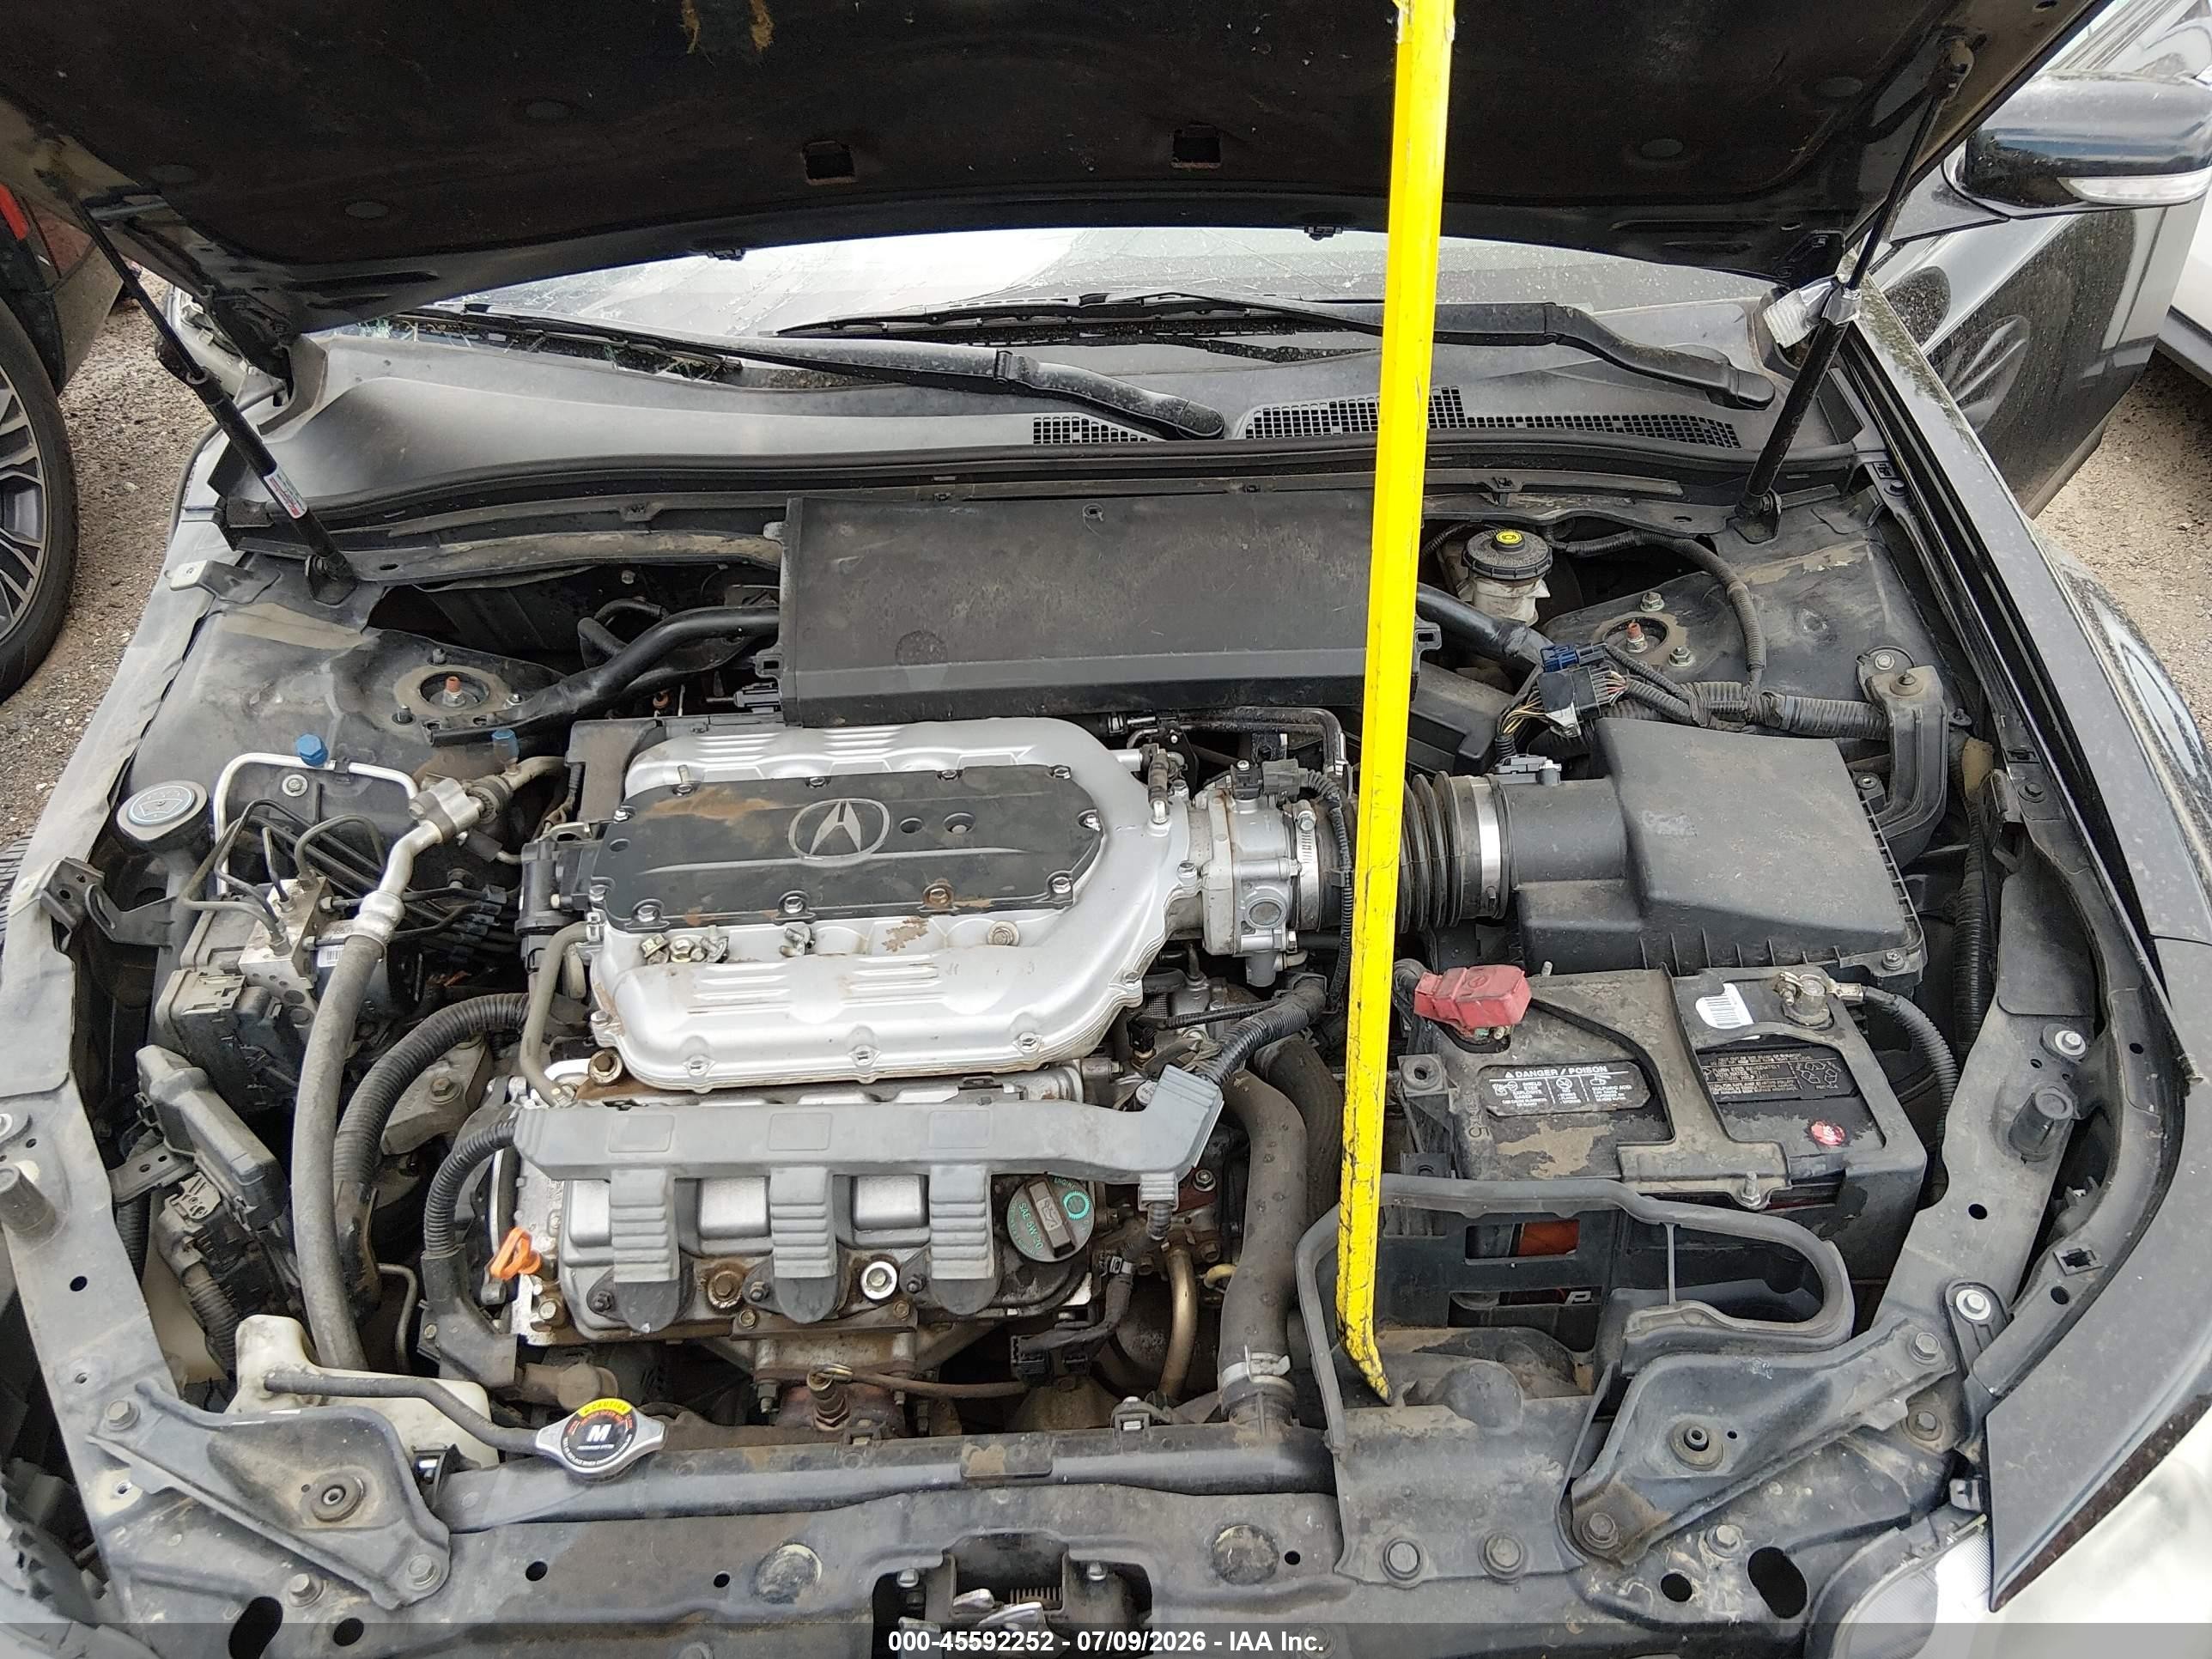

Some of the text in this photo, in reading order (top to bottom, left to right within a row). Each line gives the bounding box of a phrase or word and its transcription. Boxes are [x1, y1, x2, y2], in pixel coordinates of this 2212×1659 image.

[1515, 1070, 1559, 1079] DANGER
[1569, 1066, 1607, 1074] POISON
[1018, 1202, 1031, 1220] SAE
[592, 1401, 628, 1411] CAUTION
[586, 1424, 611, 1442] M
